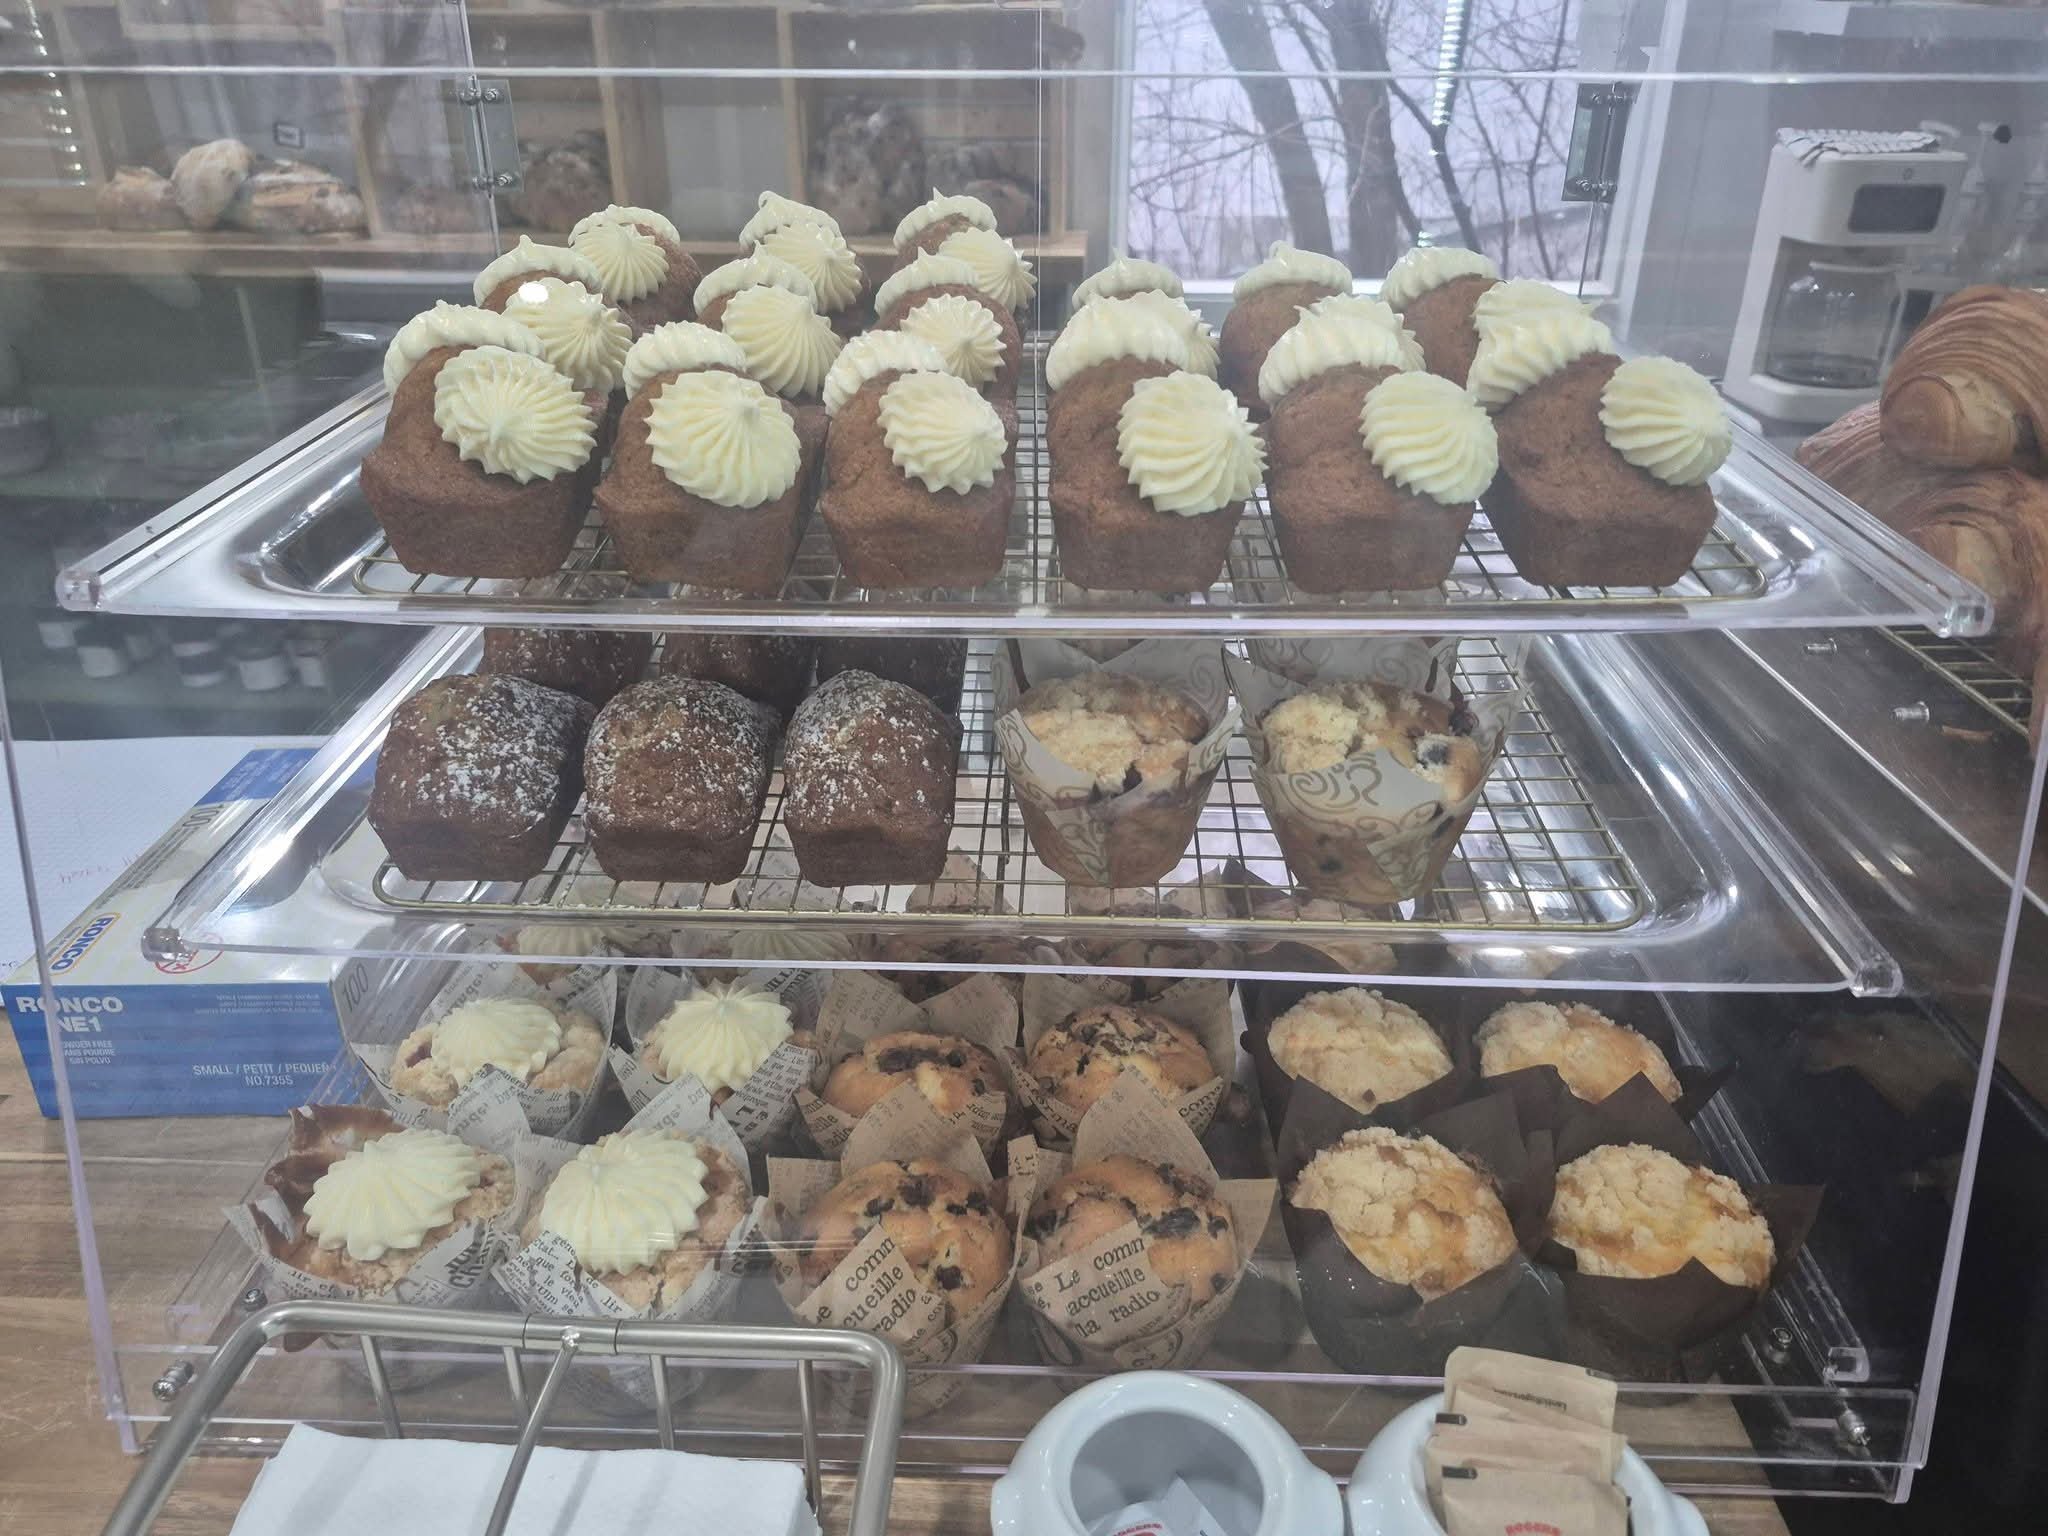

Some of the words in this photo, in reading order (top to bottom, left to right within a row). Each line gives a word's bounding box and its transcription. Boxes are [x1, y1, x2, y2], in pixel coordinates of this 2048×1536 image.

[51, 916, 114, 971] RONCO
[15, 996, 124, 1013] RONCO
[193, 1064, 233, 1076] SMALL
[243, 1063, 274, 1075] PETIT
[1054, 1268, 1081, 1293] Le
[1093, 1237, 1146, 1272] comn
[842, 1265, 905, 1329] cueille
[1065, 1266, 1146, 1316] accueille
[1109, 1289, 1161, 1323] radio
